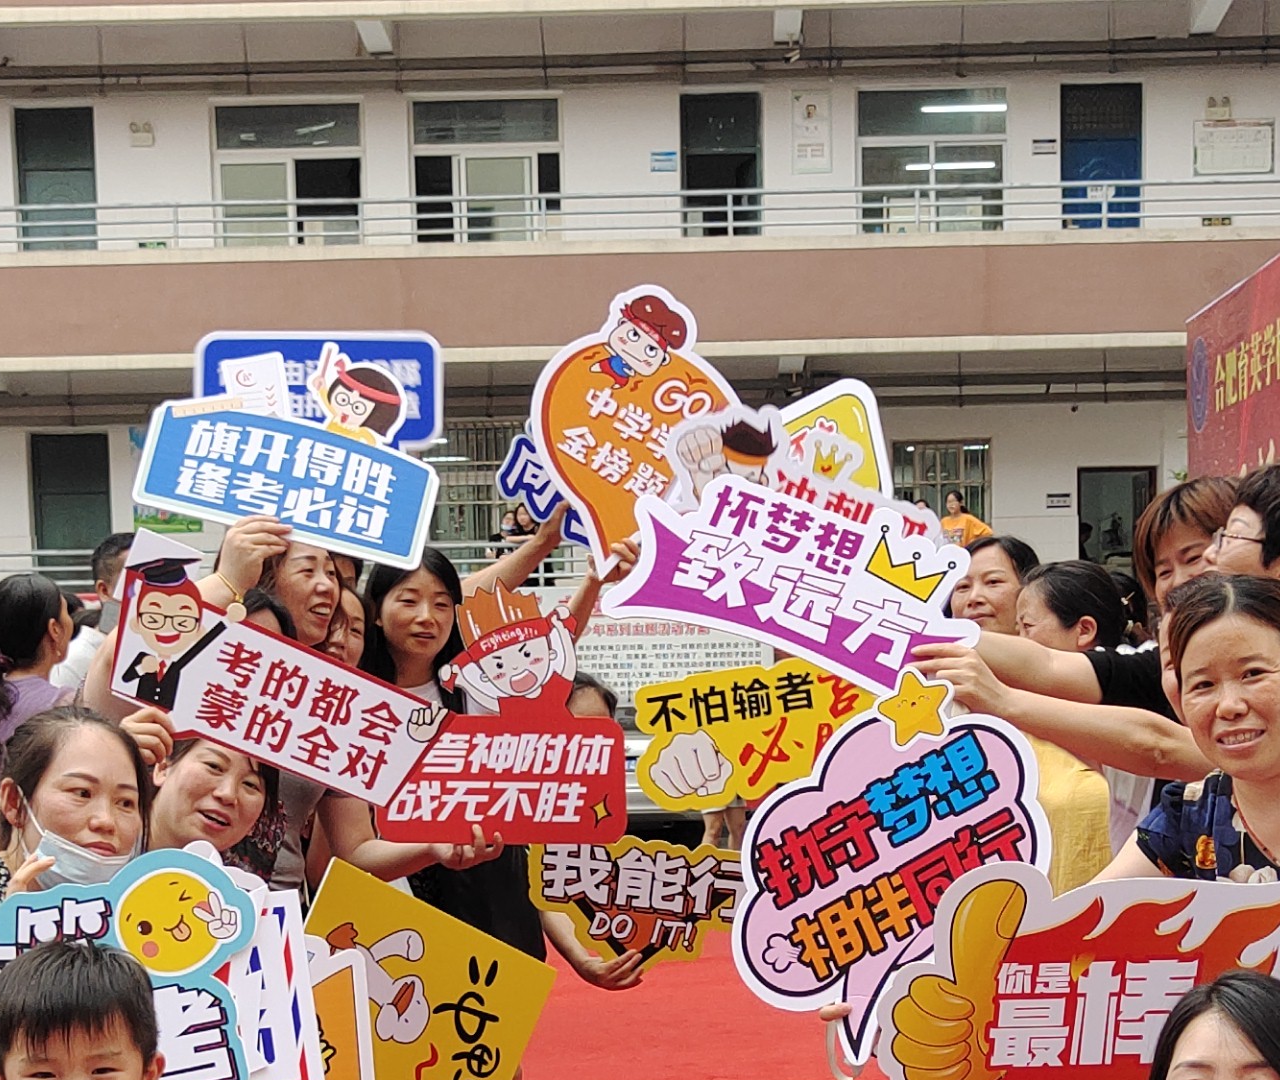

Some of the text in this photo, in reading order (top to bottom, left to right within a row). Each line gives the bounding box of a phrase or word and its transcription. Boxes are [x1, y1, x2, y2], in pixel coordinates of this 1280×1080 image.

[653, 378, 714, 421] GO
[174, 458, 390, 545] 逢考必过
[183, 419, 397, 505] 旗开得胜
[708, 484, 865, 576] 怀梦想
[671, 529, 928, 672] 致远方
[194, 681, 389, 790] 蒙的全对
[216, 639, 404, 746] 考的都会
[646, 671, 815, 733] 不怕输者
[421, 732, 616, 776] 考神附体
[386, 780, 590, 824] 战无不胜
[756, 729, 1001, 910] 执守梦想
[541, 844, 743, 918] 我能行
[588, 911, 698, 953] DO IT!
[988, 958, 1200, 1068] 最棒
[996, 961, 1071, 994] 你是
